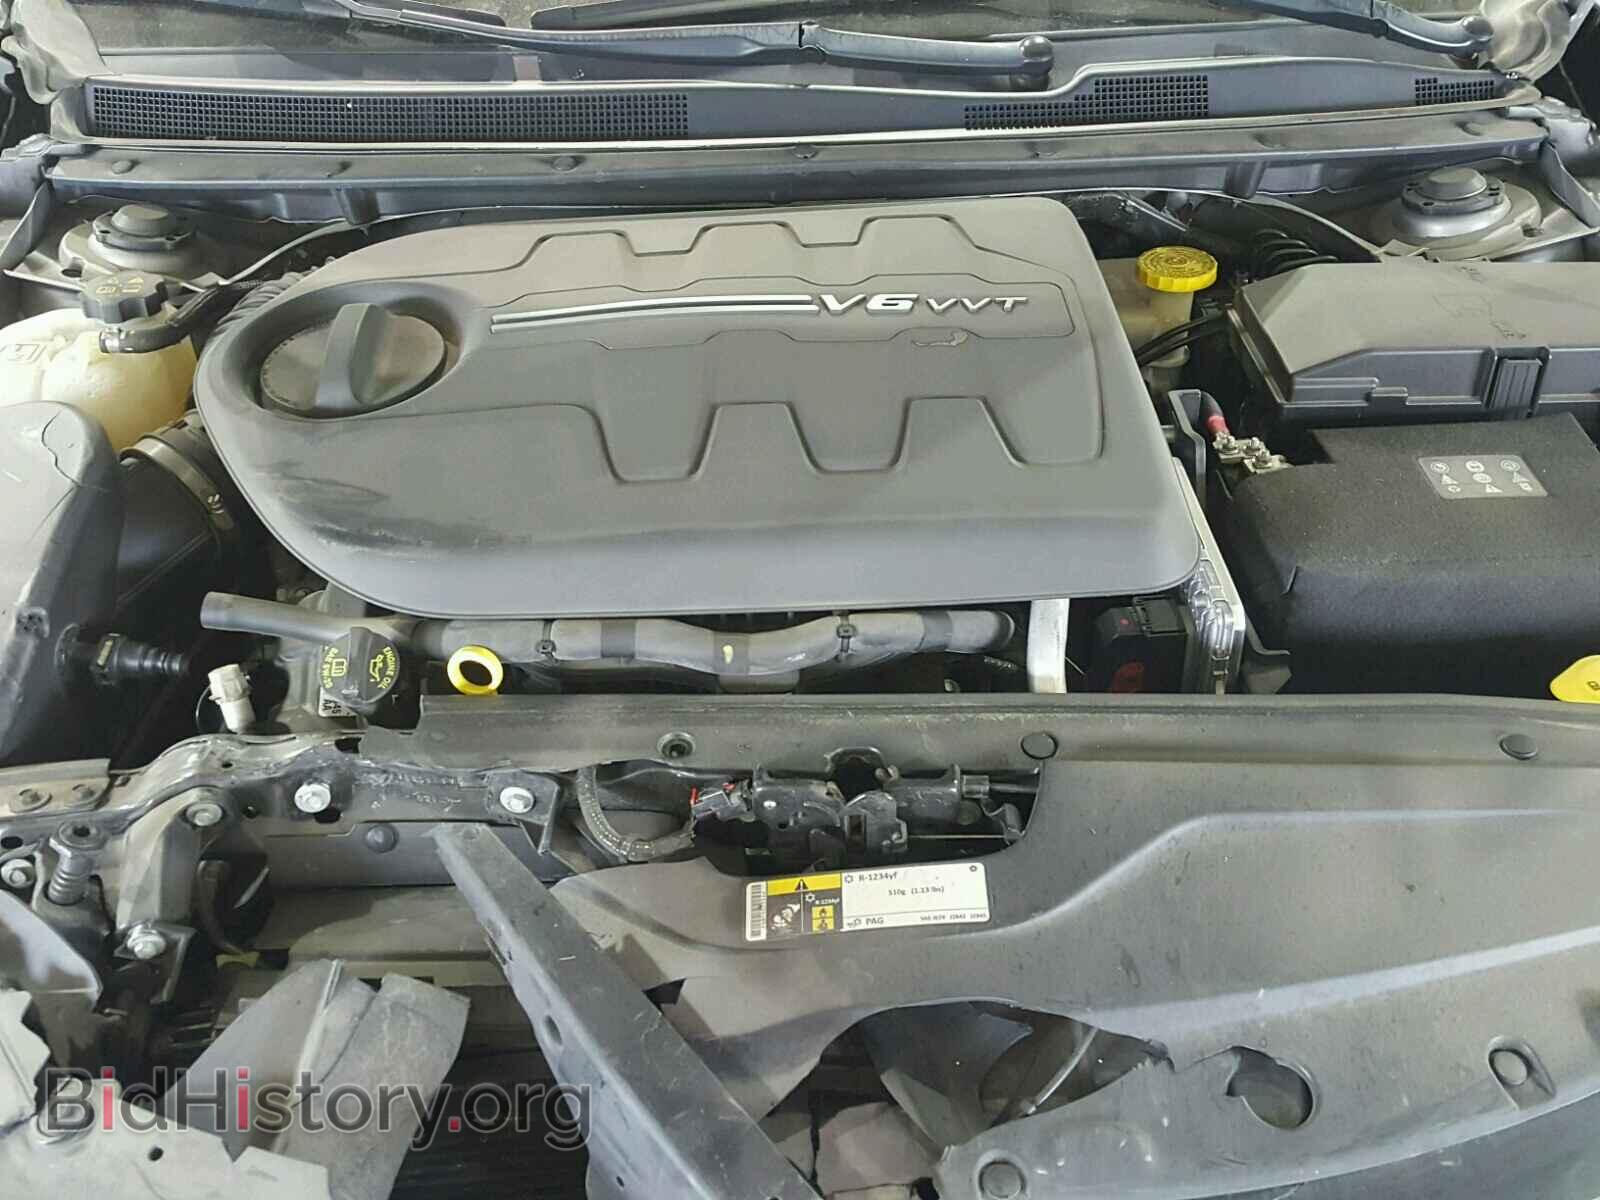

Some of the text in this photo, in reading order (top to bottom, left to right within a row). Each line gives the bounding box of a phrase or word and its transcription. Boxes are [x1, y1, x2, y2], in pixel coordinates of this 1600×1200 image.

[819, 293, 1029, 314] V6 VVT
[377, 646, 396, 689] ENGINE OIL
[858, 871, 898, 881] R-1234yf
[865, 917, 884, 926] PAG
